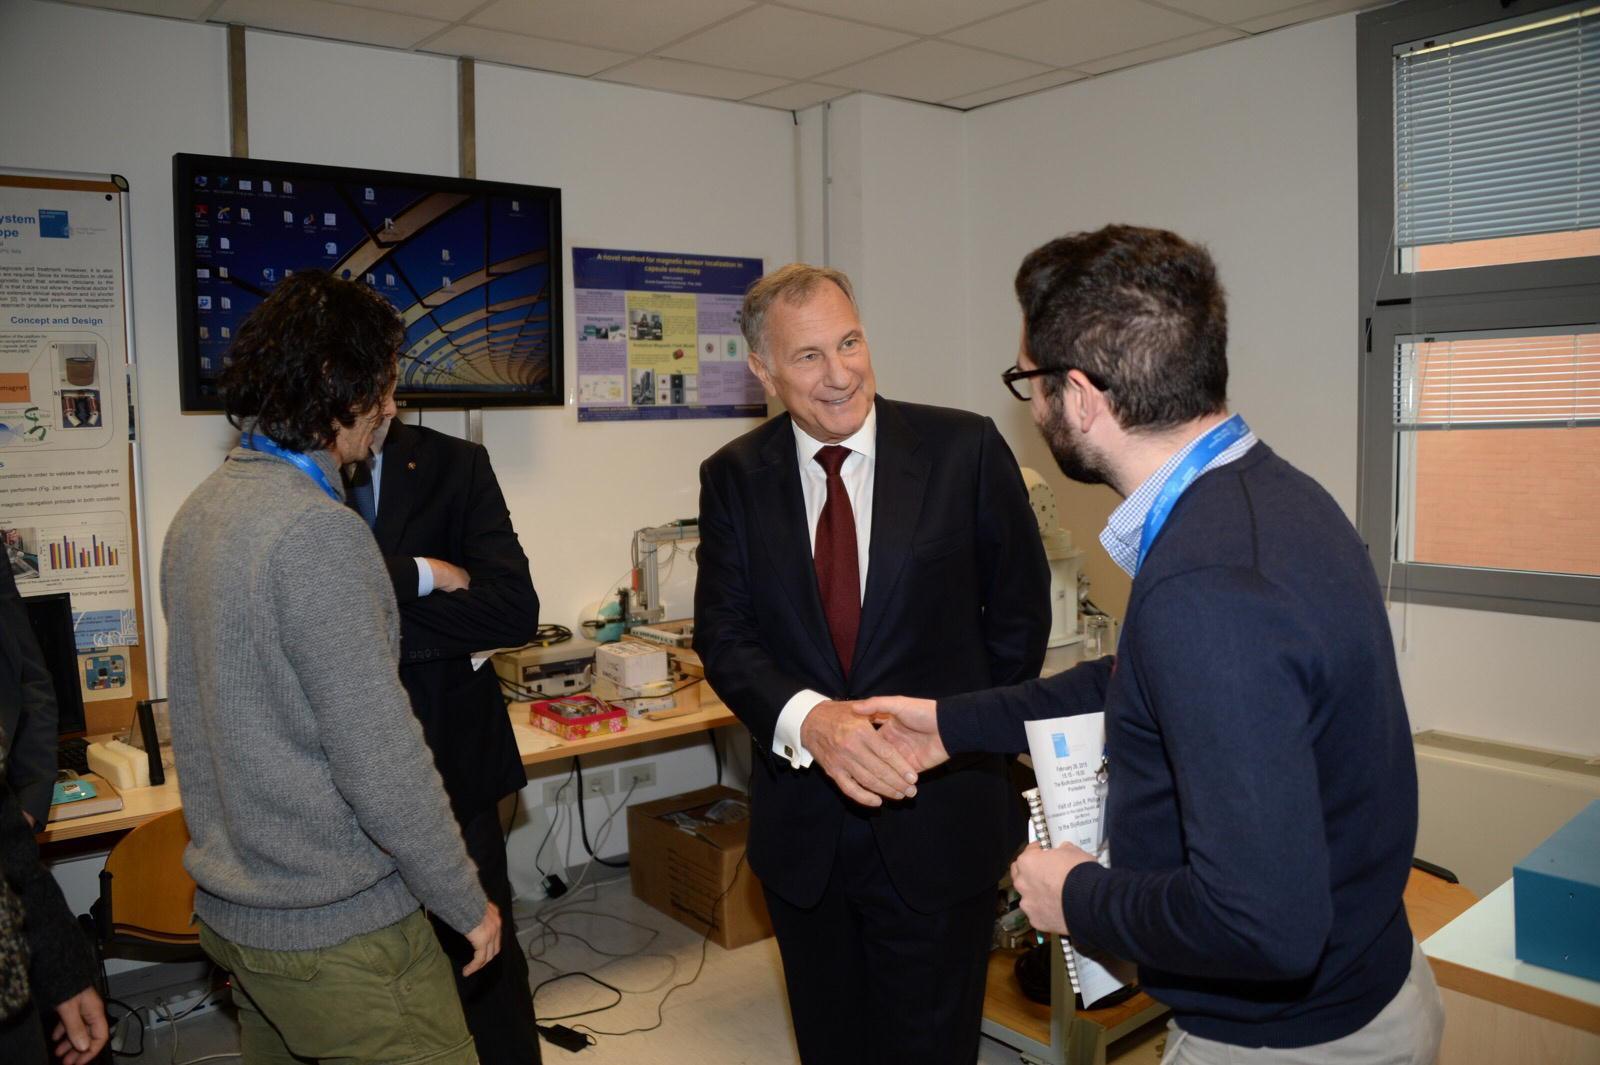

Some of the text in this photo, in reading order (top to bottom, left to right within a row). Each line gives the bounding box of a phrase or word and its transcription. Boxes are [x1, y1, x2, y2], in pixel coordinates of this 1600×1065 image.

[603, 254, 621, 262] novel
[622, 255, 645, 263] method
[646, 256, 656, 264] for
[656, 257, 683, 266] magnetic
[644, 265, 701, 276] capsule endoscopy
[10, 316, 103, 327] Concept and Design
